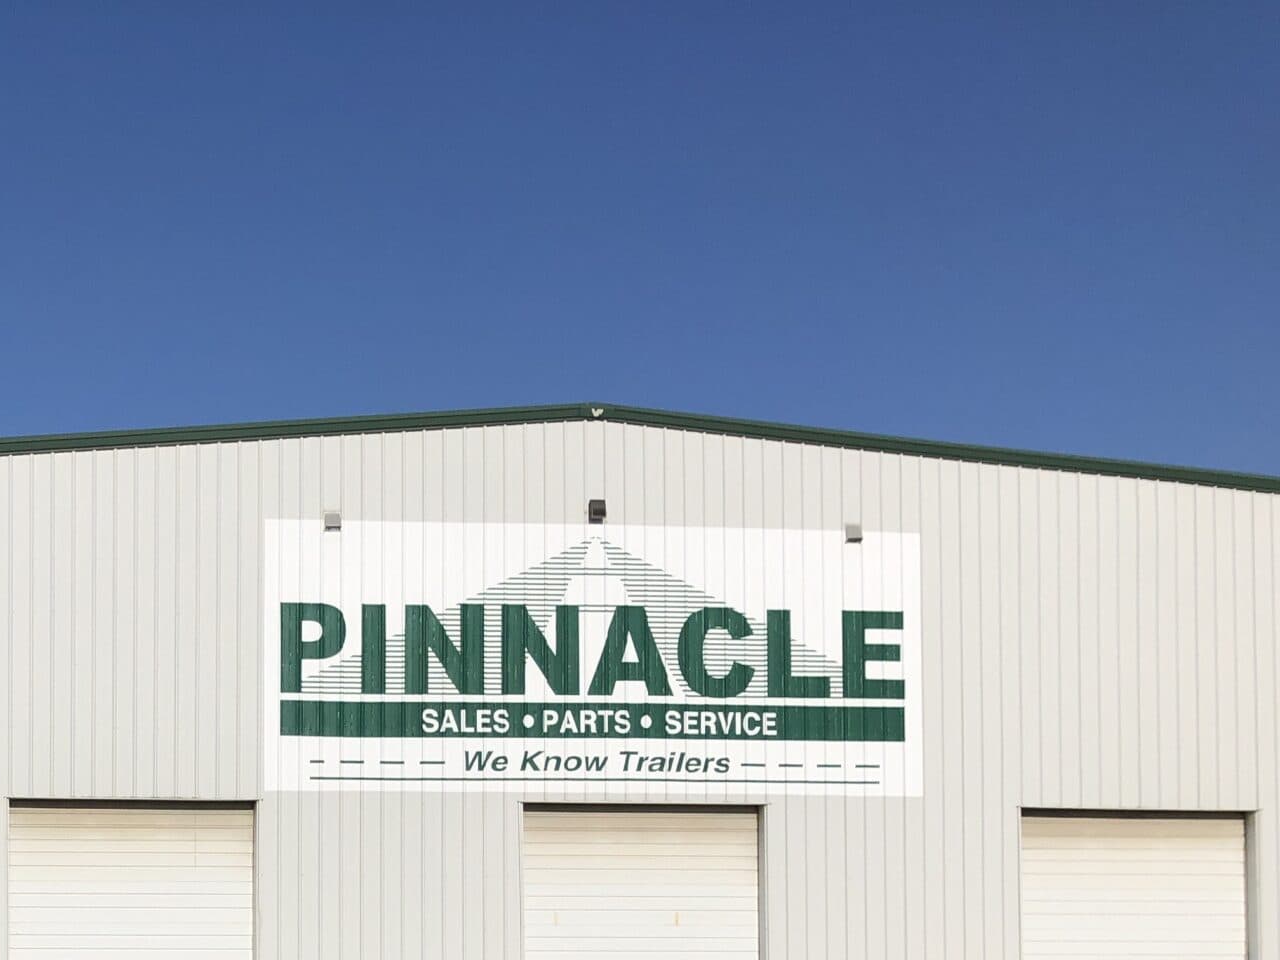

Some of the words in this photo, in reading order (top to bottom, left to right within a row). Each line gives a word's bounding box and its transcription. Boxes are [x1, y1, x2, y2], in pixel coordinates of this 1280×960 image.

[280, 602, 905, 698] PINNACLE
[422, 709, 510, 733] SALES
[542, 709, 631, 734] PARTS
[665, 711, 778, 736] SERVICE
[464, 750, 509, 771] We
[520, 750, 608, 772] Know
[619, 751, 730, 773] Trailers
